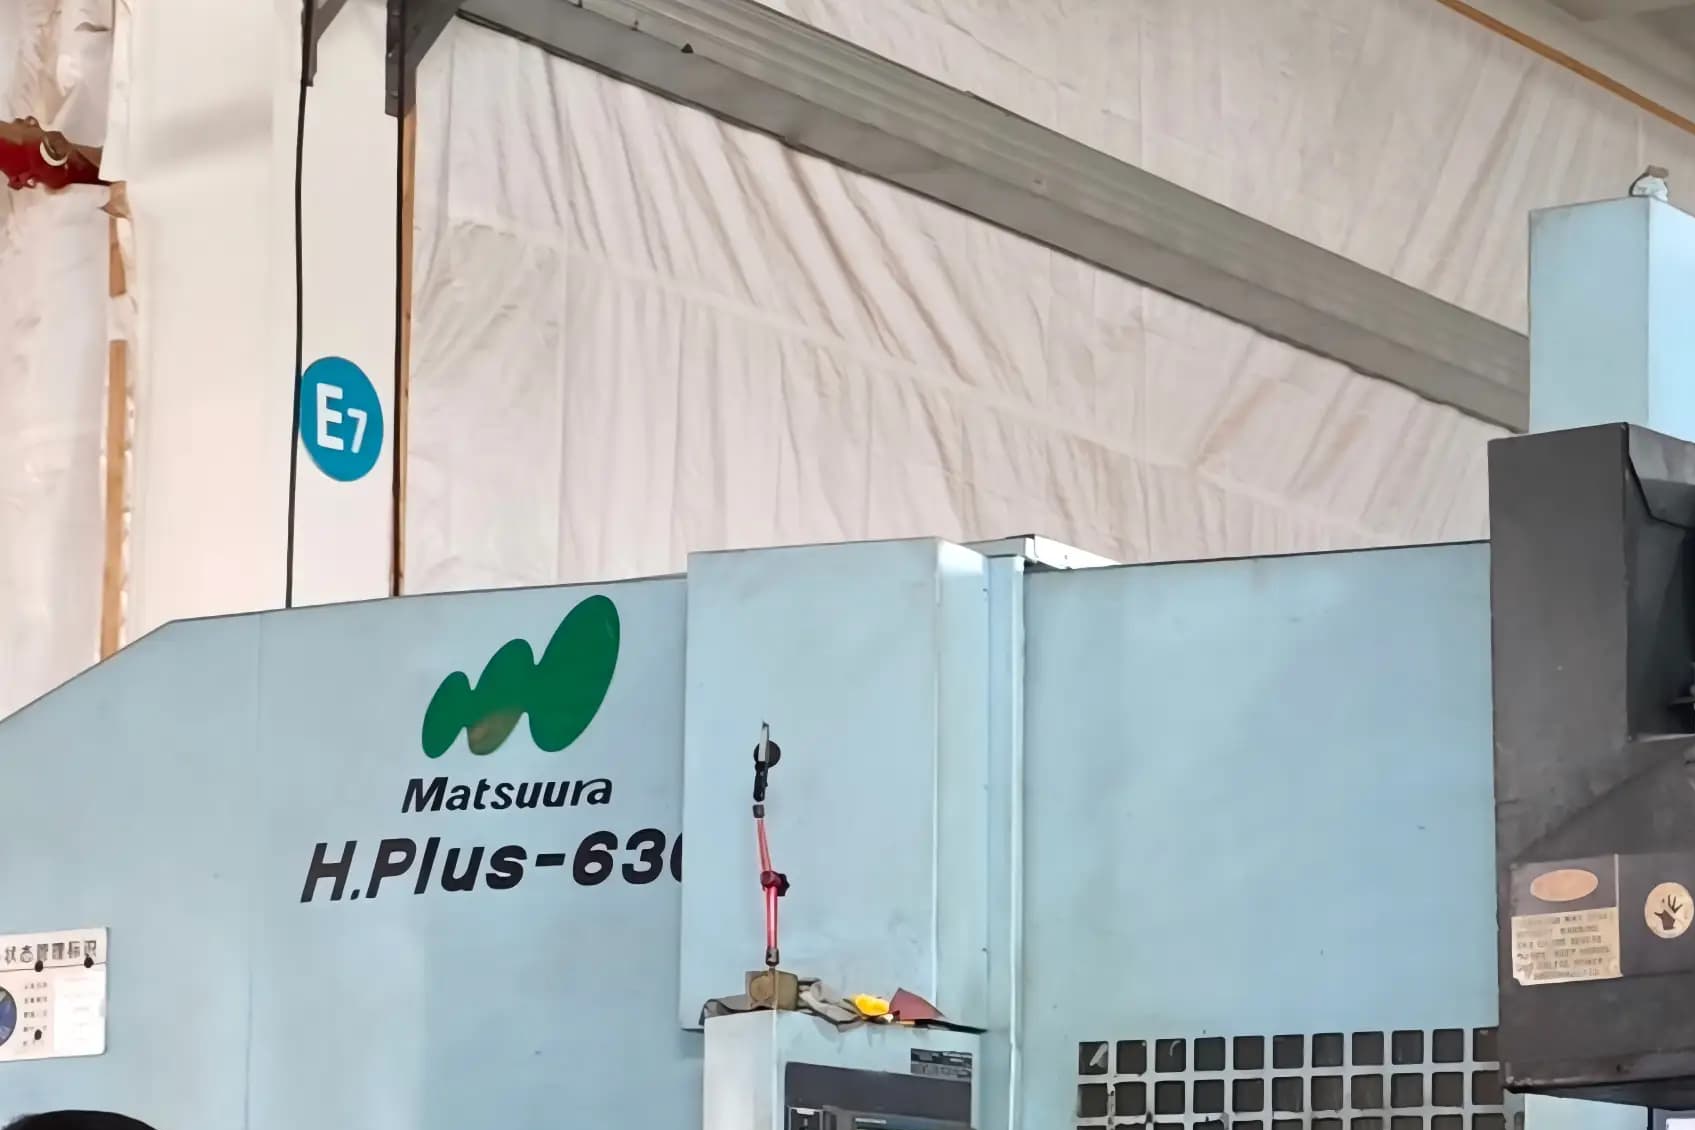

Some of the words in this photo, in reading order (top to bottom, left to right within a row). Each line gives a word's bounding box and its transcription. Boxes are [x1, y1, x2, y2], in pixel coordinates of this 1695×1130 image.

[316, 382, 367, 454] E7
[401, 776, 613, 813] Matsuura
[299, 827, 683, 904] H.Plus-63
